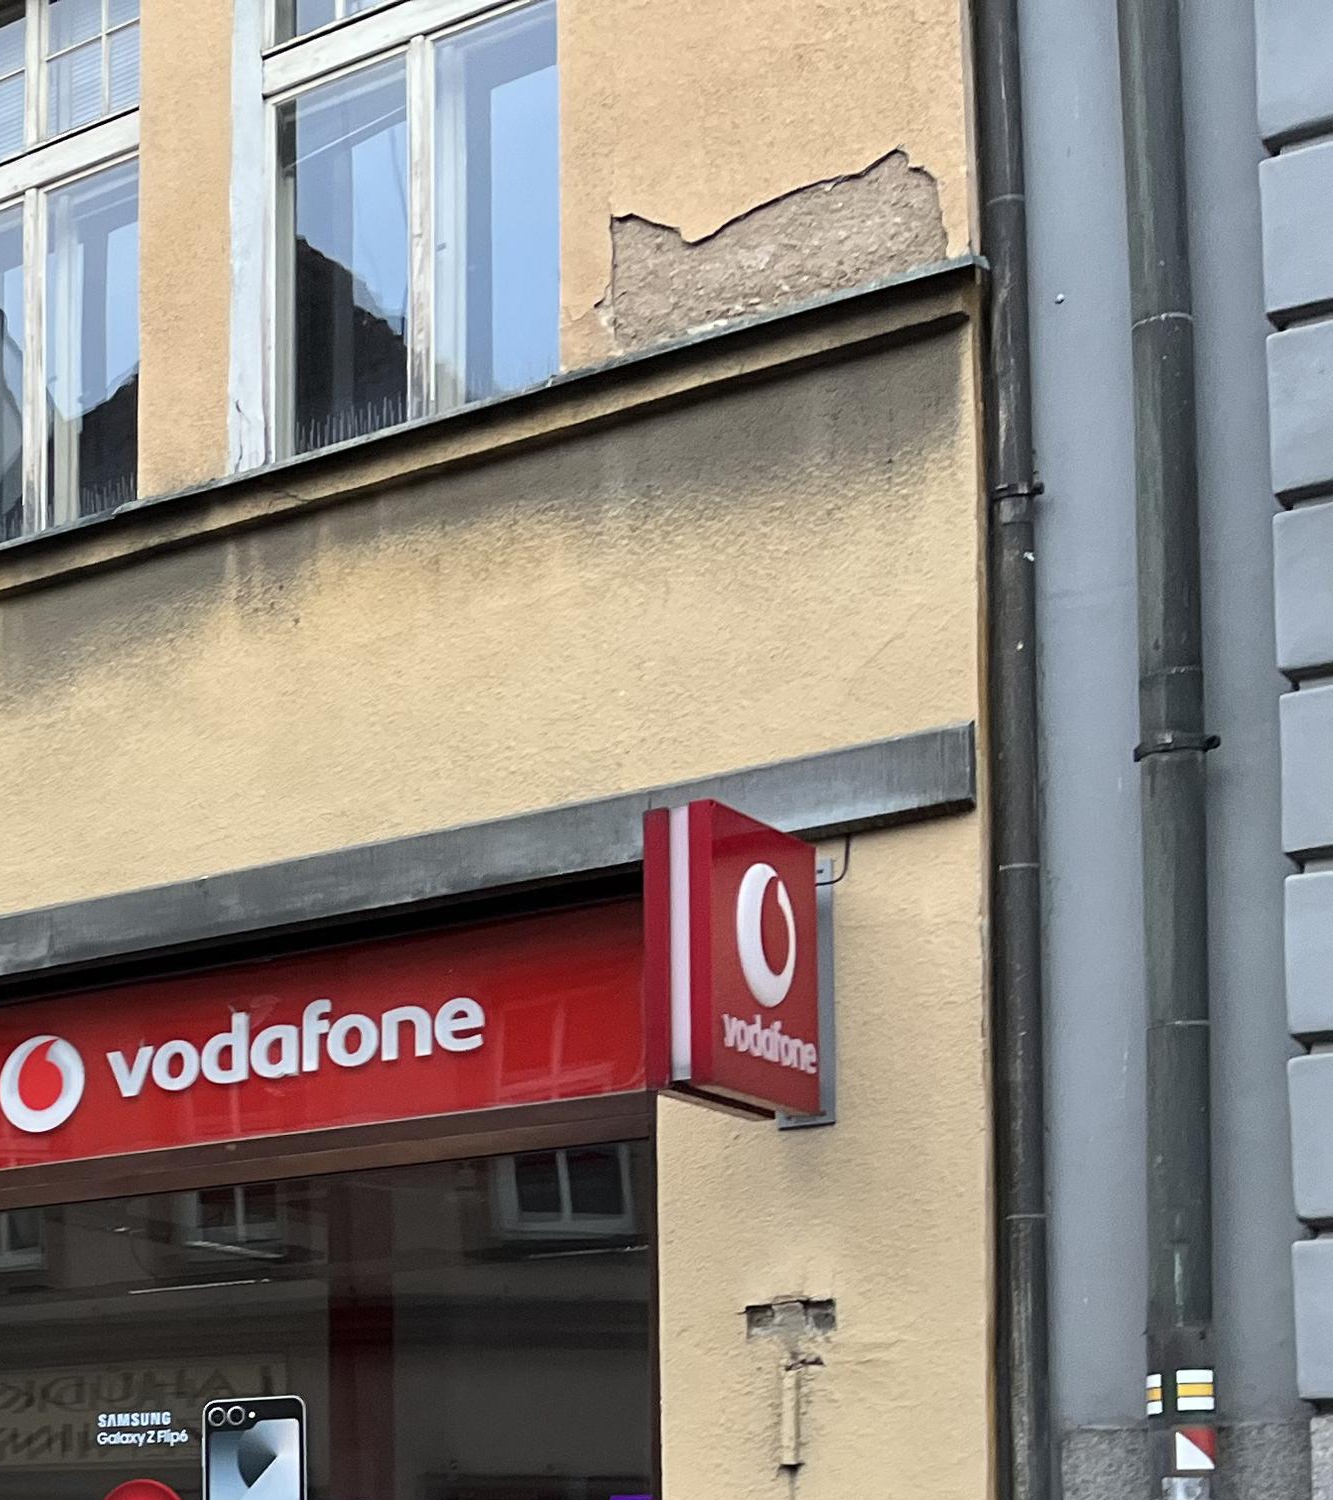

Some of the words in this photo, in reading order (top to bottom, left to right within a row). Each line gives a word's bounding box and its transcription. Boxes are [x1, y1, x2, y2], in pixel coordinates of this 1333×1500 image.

[105, 996, 486, 1099] vodafone
[721, 1013, 817, 1075] vodafone
[96, 1431, 145, 1447] Galaxy
[146, 1431, 155, 1443] Z
[156, 1428, 189, 1447] Flip6
[97, 1411, 172, 1428] SAMSUNG
